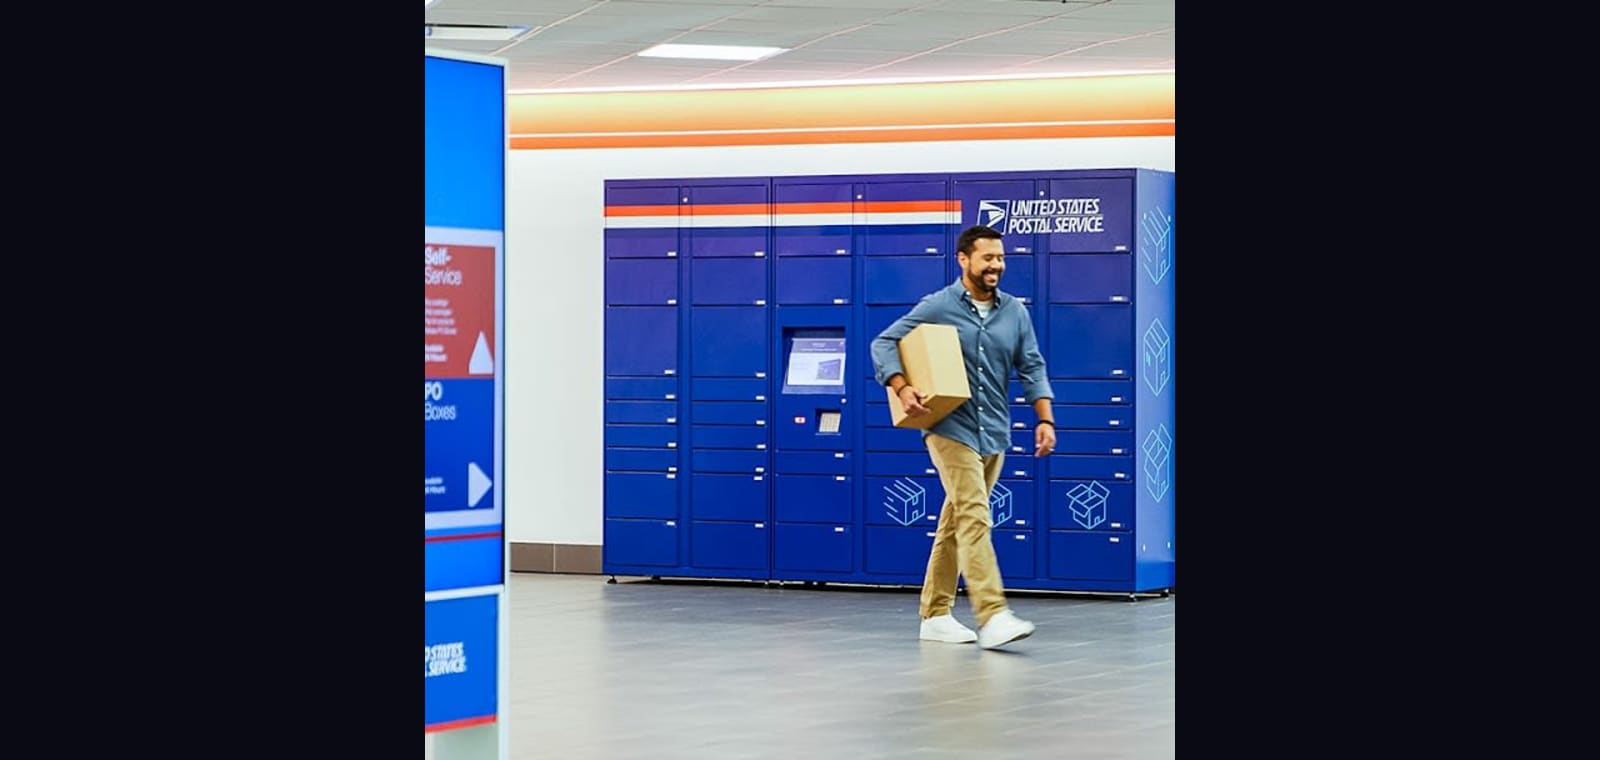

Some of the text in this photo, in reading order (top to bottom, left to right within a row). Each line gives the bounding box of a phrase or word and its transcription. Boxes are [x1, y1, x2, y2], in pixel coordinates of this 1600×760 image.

[1010, 198, 1100, 216] UNITED STATES
[1008, 216, 1104, 234] POSTAL SERVICE
[425, 246, 452, 266] Self-
[425, 266, 463, 286] Service
[425, 381, 443, 401] PO
[425, 401, 457, 421] Boxes
[430, 642, 464, 660] STATES
[428, 656, 467, 677] SERVICE
